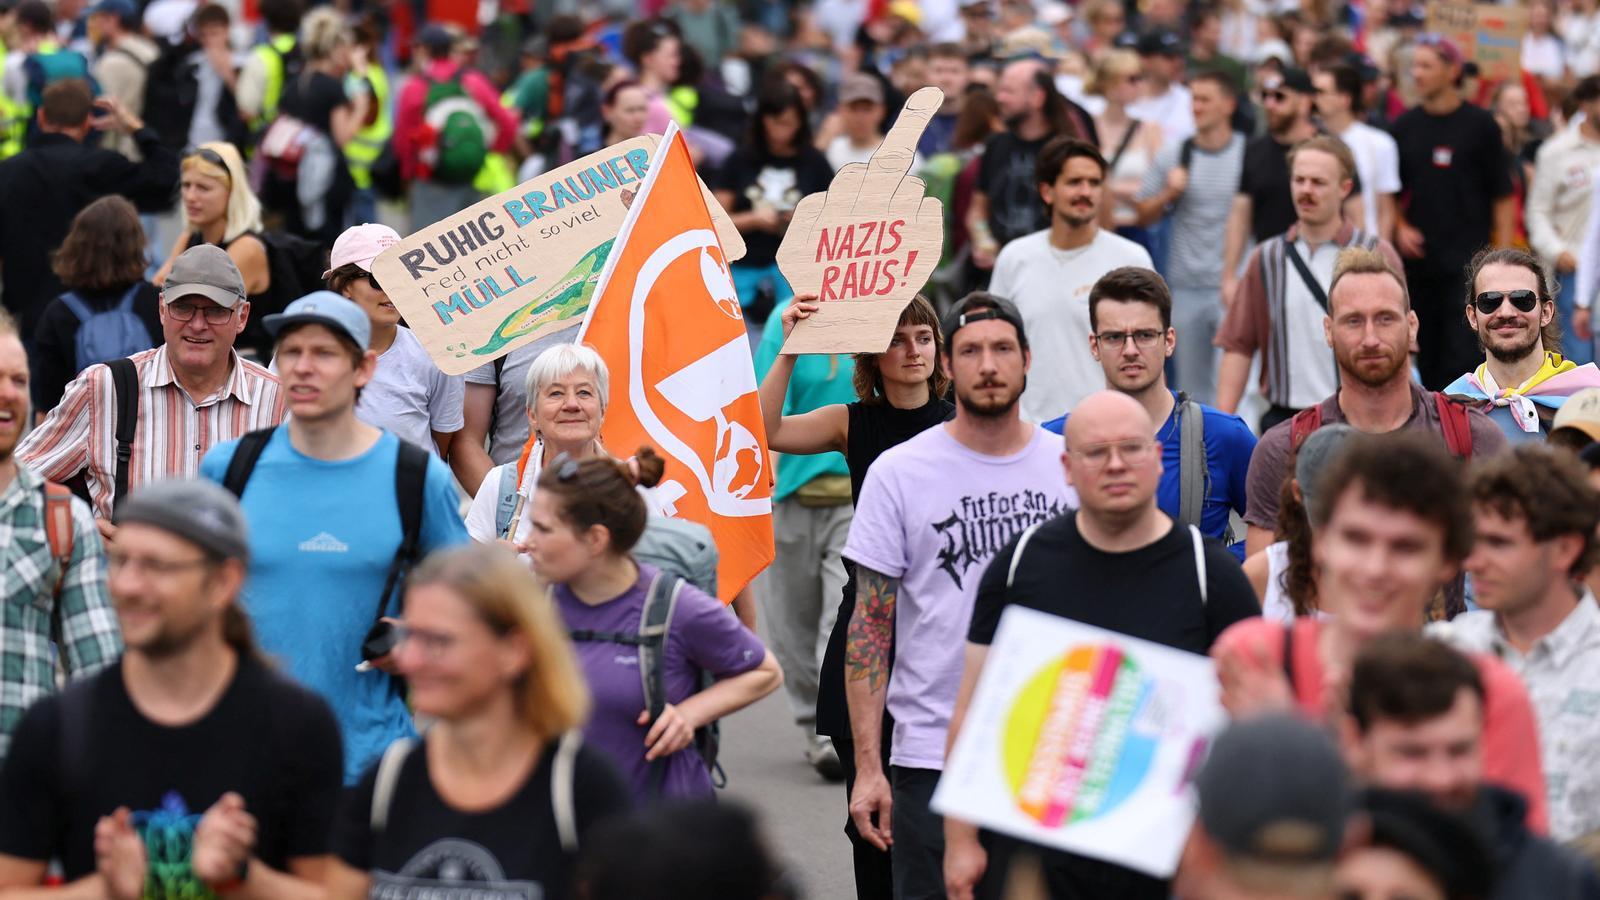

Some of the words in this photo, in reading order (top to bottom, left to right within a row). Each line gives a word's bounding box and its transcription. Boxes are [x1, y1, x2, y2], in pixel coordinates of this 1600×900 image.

[398, 211, 505, 280] RUHIG
[503, 148, 649, 228] BRAUNER
[815, 219, 905, 263] NAZIS
[421, 266, 467, 298] red
[474, 234, 530, 271] nicht
[431, 264, 537, 325] MÜLL
[819, 250, 918, 302] RAUS!
